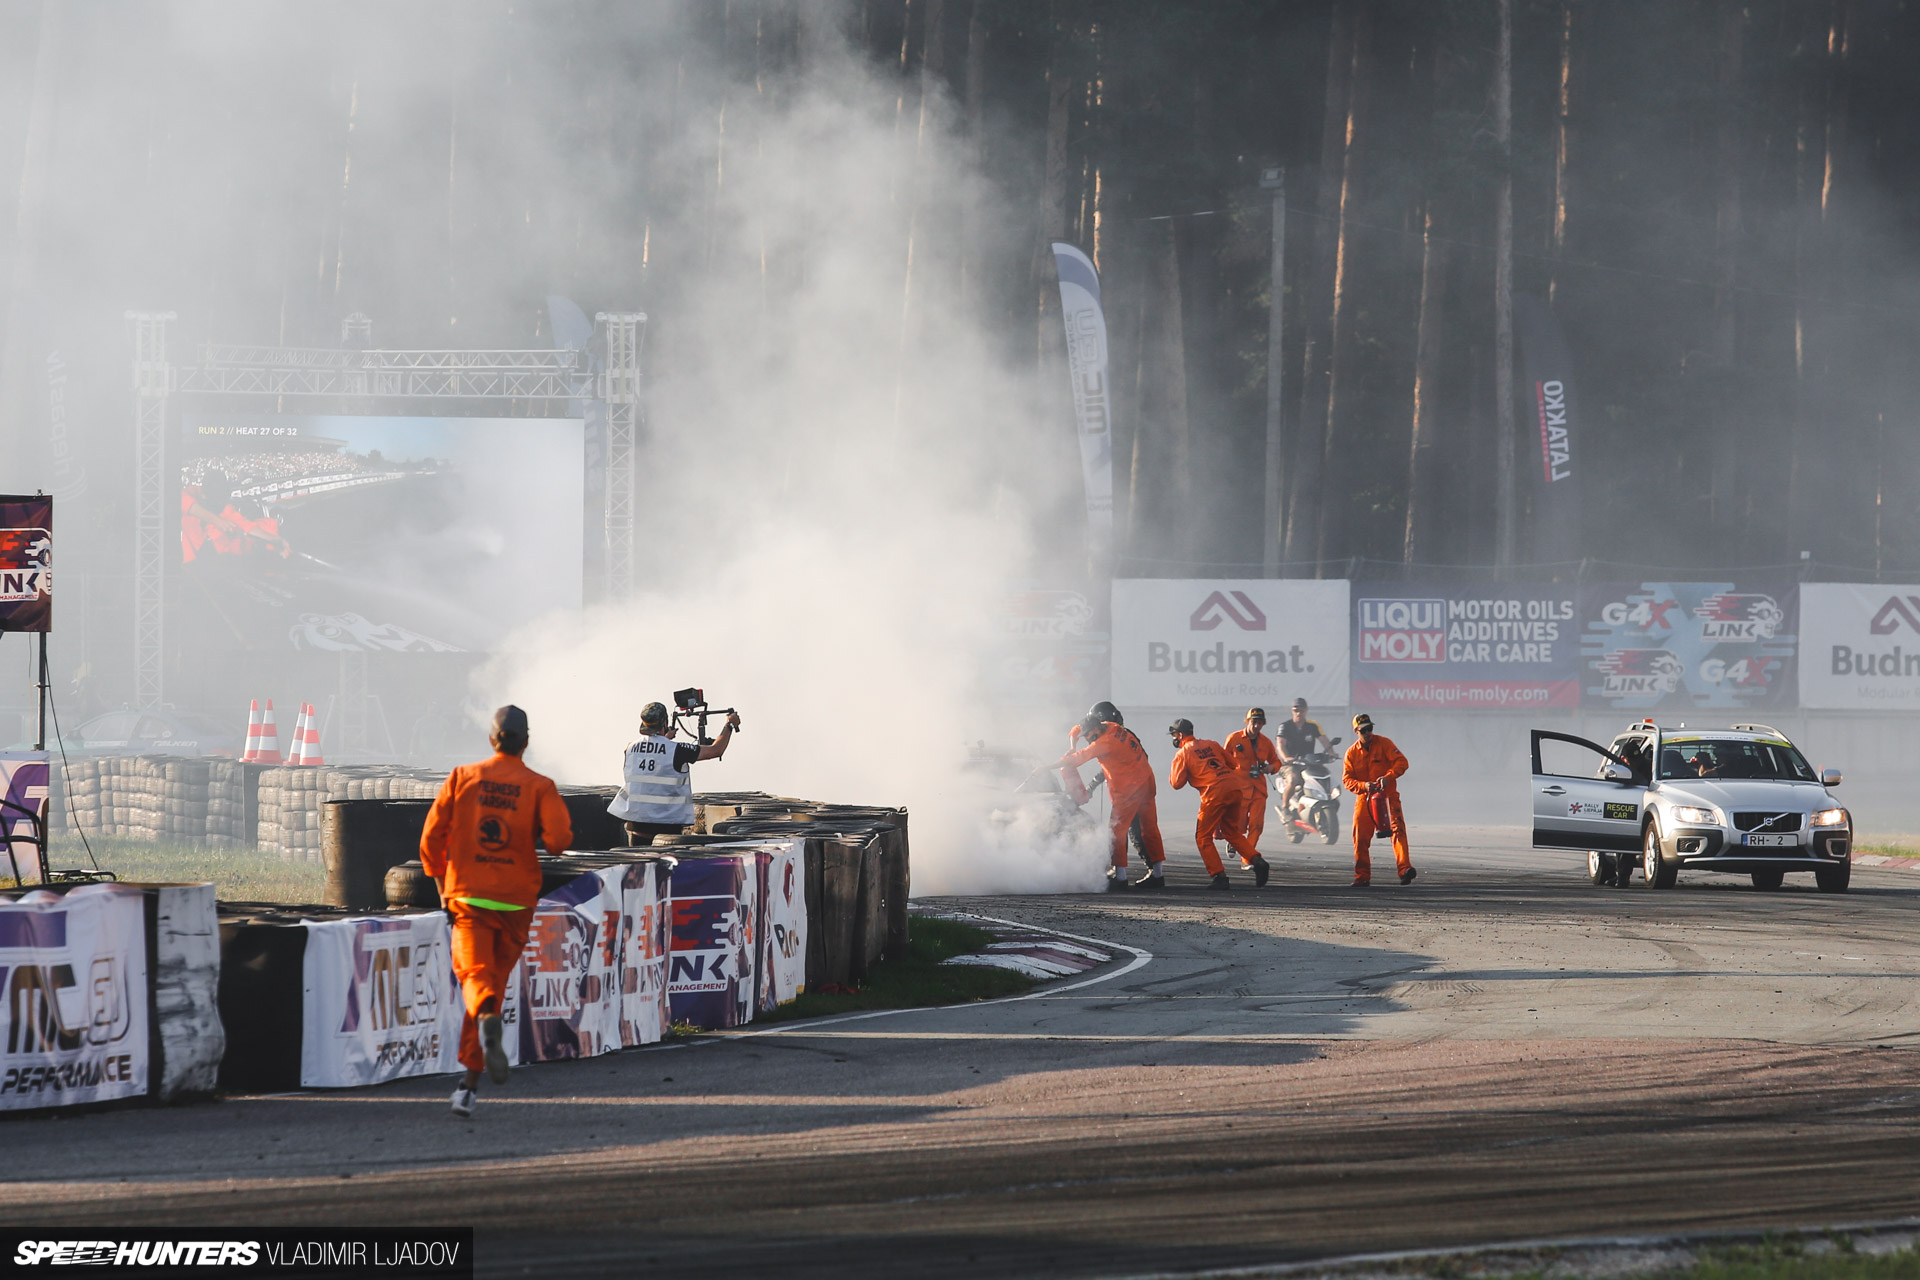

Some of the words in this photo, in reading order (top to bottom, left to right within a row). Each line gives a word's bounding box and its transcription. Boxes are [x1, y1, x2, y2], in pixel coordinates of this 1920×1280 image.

[236, 427, 258, 435] HEAT
[1364, 602, 1441, 630] LIQUI
[1449, 601, 1522, 620] MOTOR
[1527, 601, 1574, 620] OILS
[1602, 600, 1675, 630] G4X
[1448, 622, 1559, 641] ADDITIVES
[1702, 623, 1757, 637] LINK
[1364, 633, 1444, 659] MOLY
[1449, 643, 1491, 662] CAR
[1496, 643, 1552, 662] CARE
[1148, 642, 1315, 673] Budmat.
[1700, 656, 1774, 686] G4X
[1177, 684, 1234, 696] Modular
[1239, 684, 1279, 696] Roofs
[1379, 684, 1549, 704] www.liqui-moly.com
[1605, 678, 1659, 692] LINK
[631, 742, 666, 755] MEDIA
[639, 759, 655, 771] 48
[1607, 804, 1635, 812] RESCUE
[1777, 836, 1783, 845] 2
[530, 977, 570, 1007] LINK
[667, 982, 727, 992] ANAGEMENT
